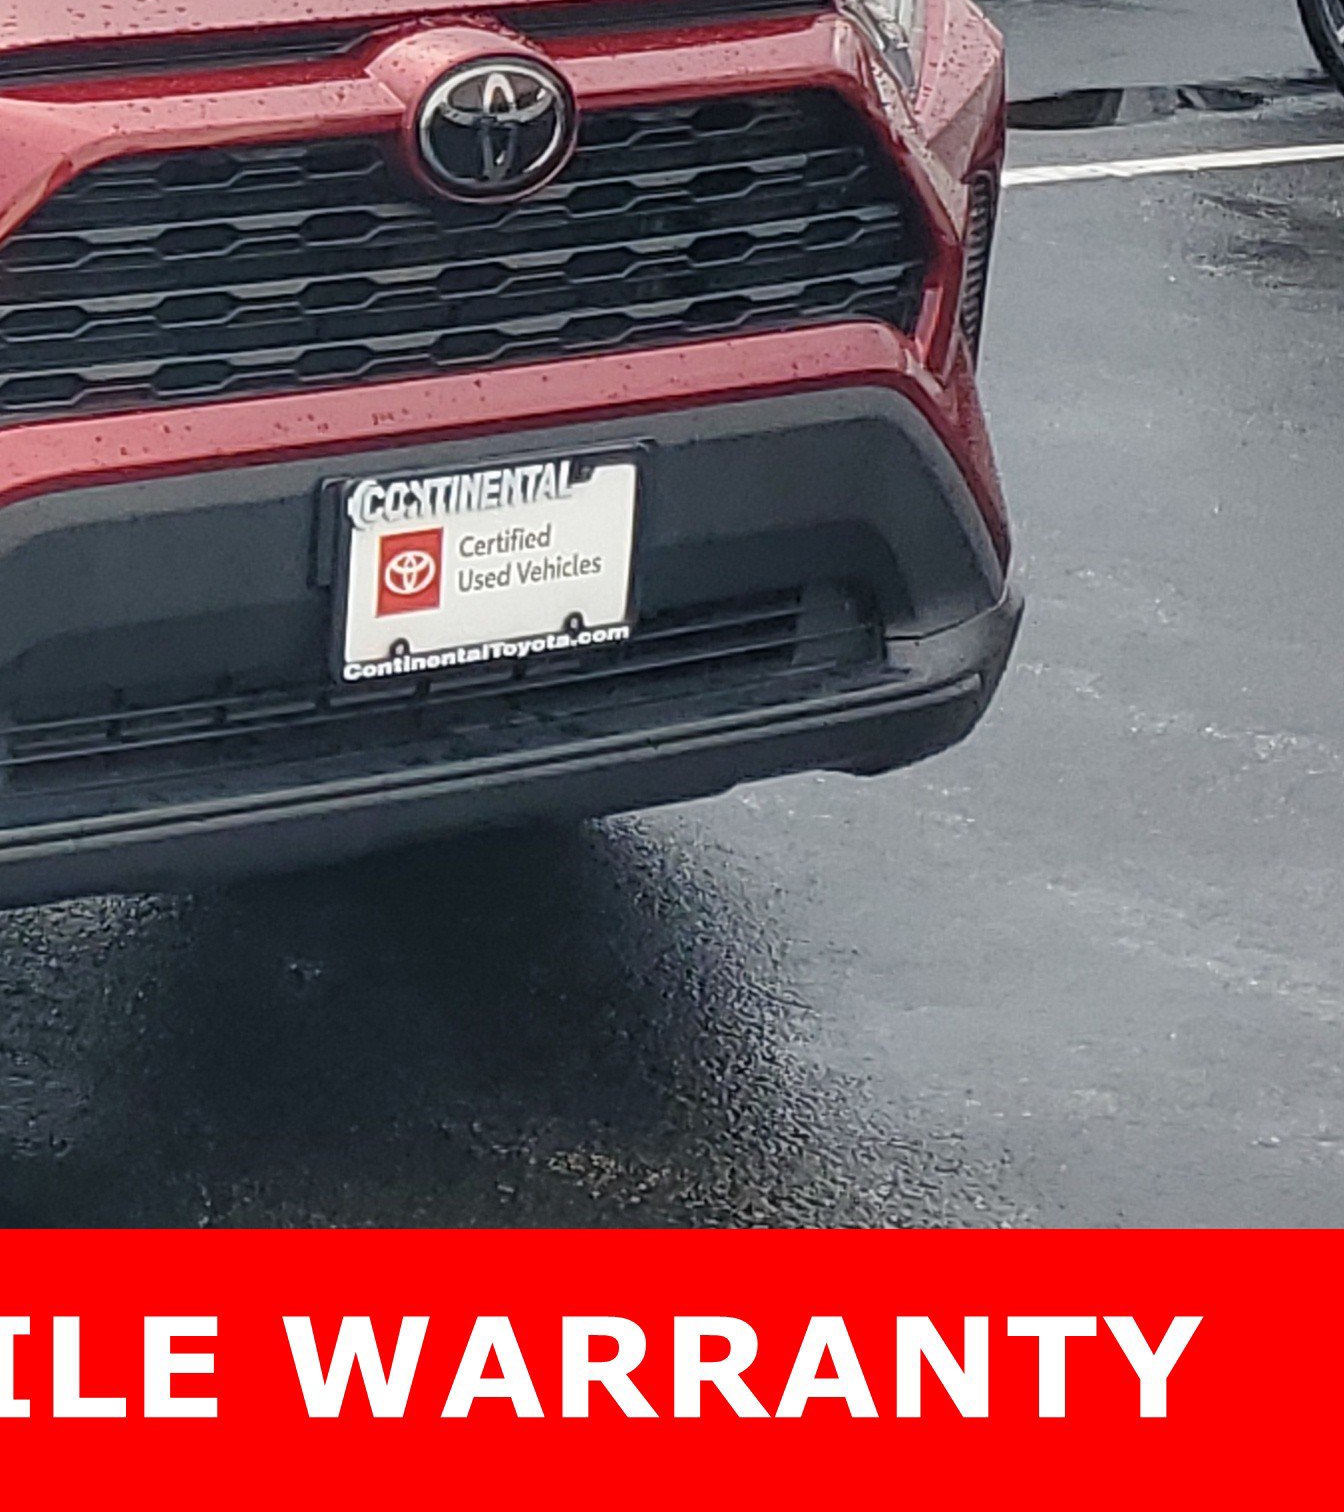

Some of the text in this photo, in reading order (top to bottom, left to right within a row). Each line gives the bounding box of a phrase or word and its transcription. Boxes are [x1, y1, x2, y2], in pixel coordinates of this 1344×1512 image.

[458, 524, 552, 558] Certified
[458, 555, 602, 592] Used Vehicles
[344, 625, 630, 680] ContinentalToyota.com
